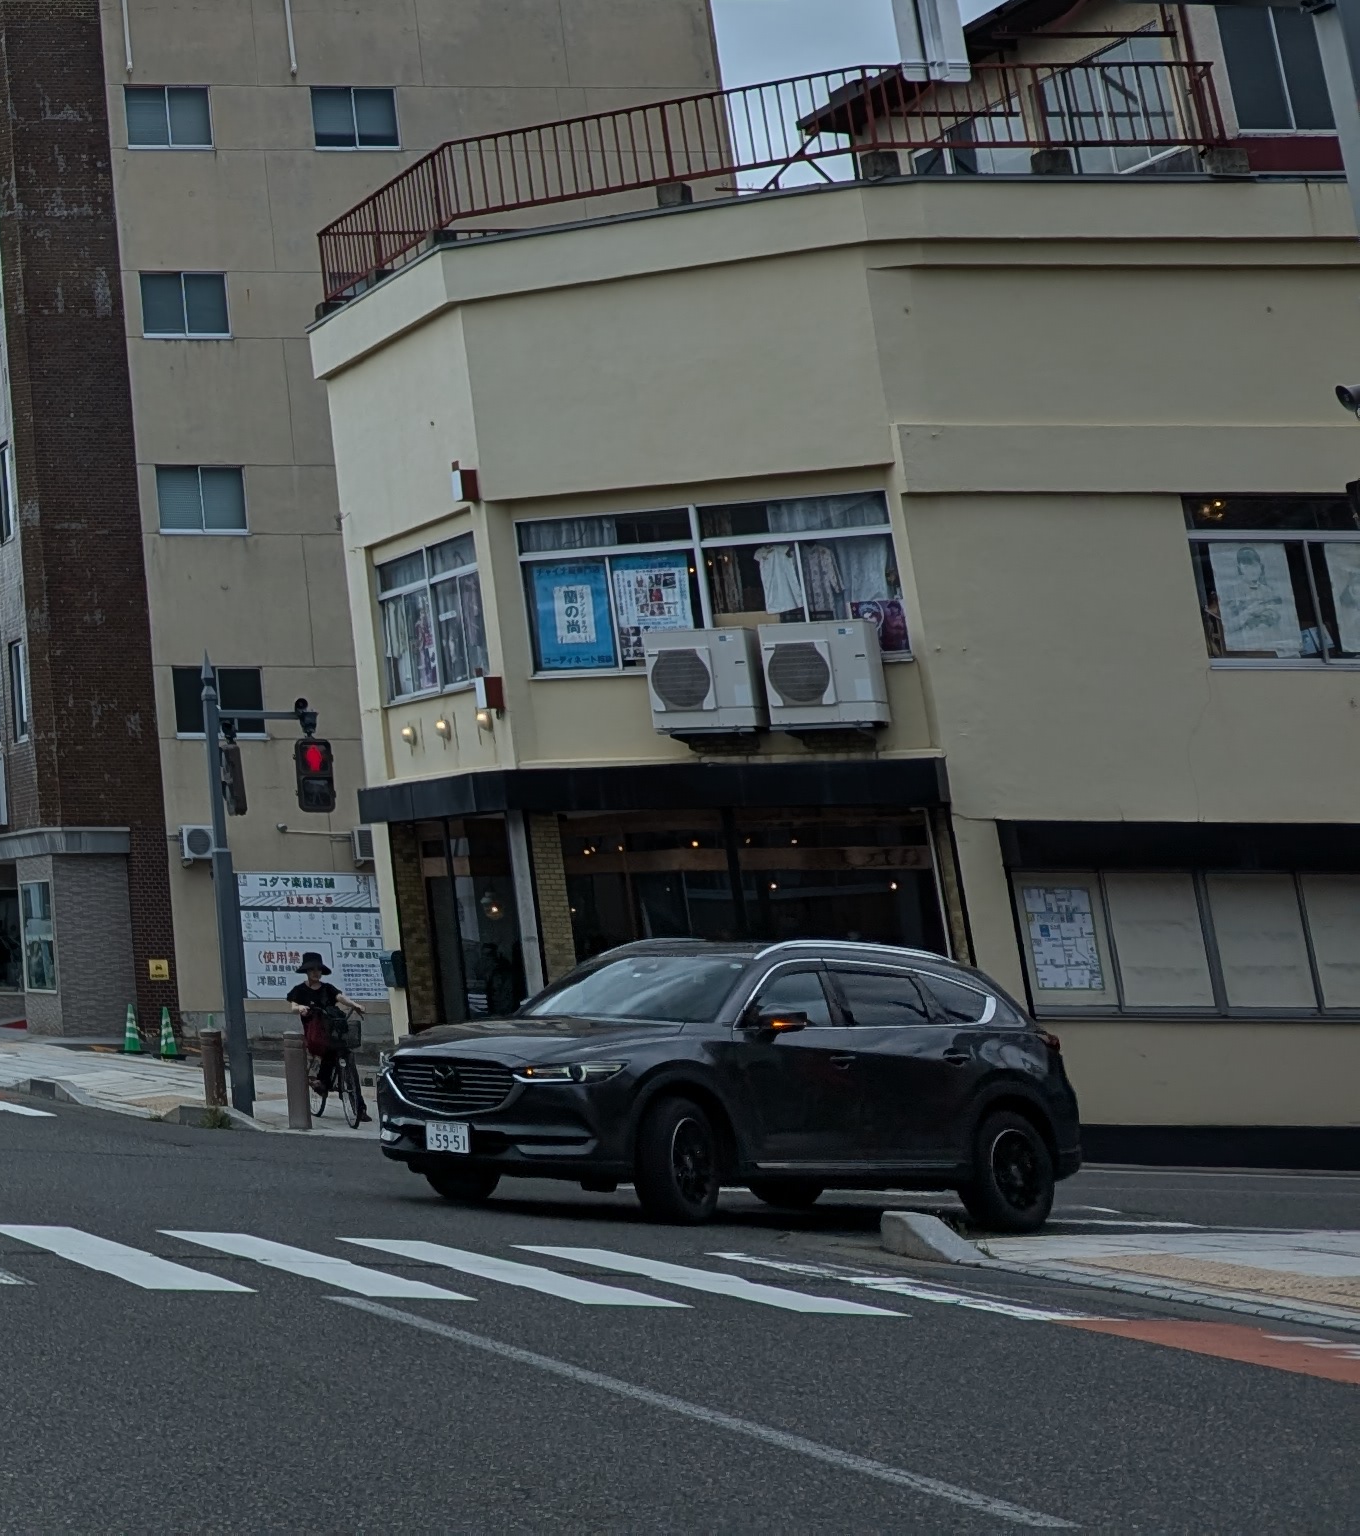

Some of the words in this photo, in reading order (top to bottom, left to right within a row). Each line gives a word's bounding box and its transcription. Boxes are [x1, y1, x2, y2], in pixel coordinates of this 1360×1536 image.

[258, 951, 300, 964] (使用禁
[435, 1133, 466, 1151] 59-51
